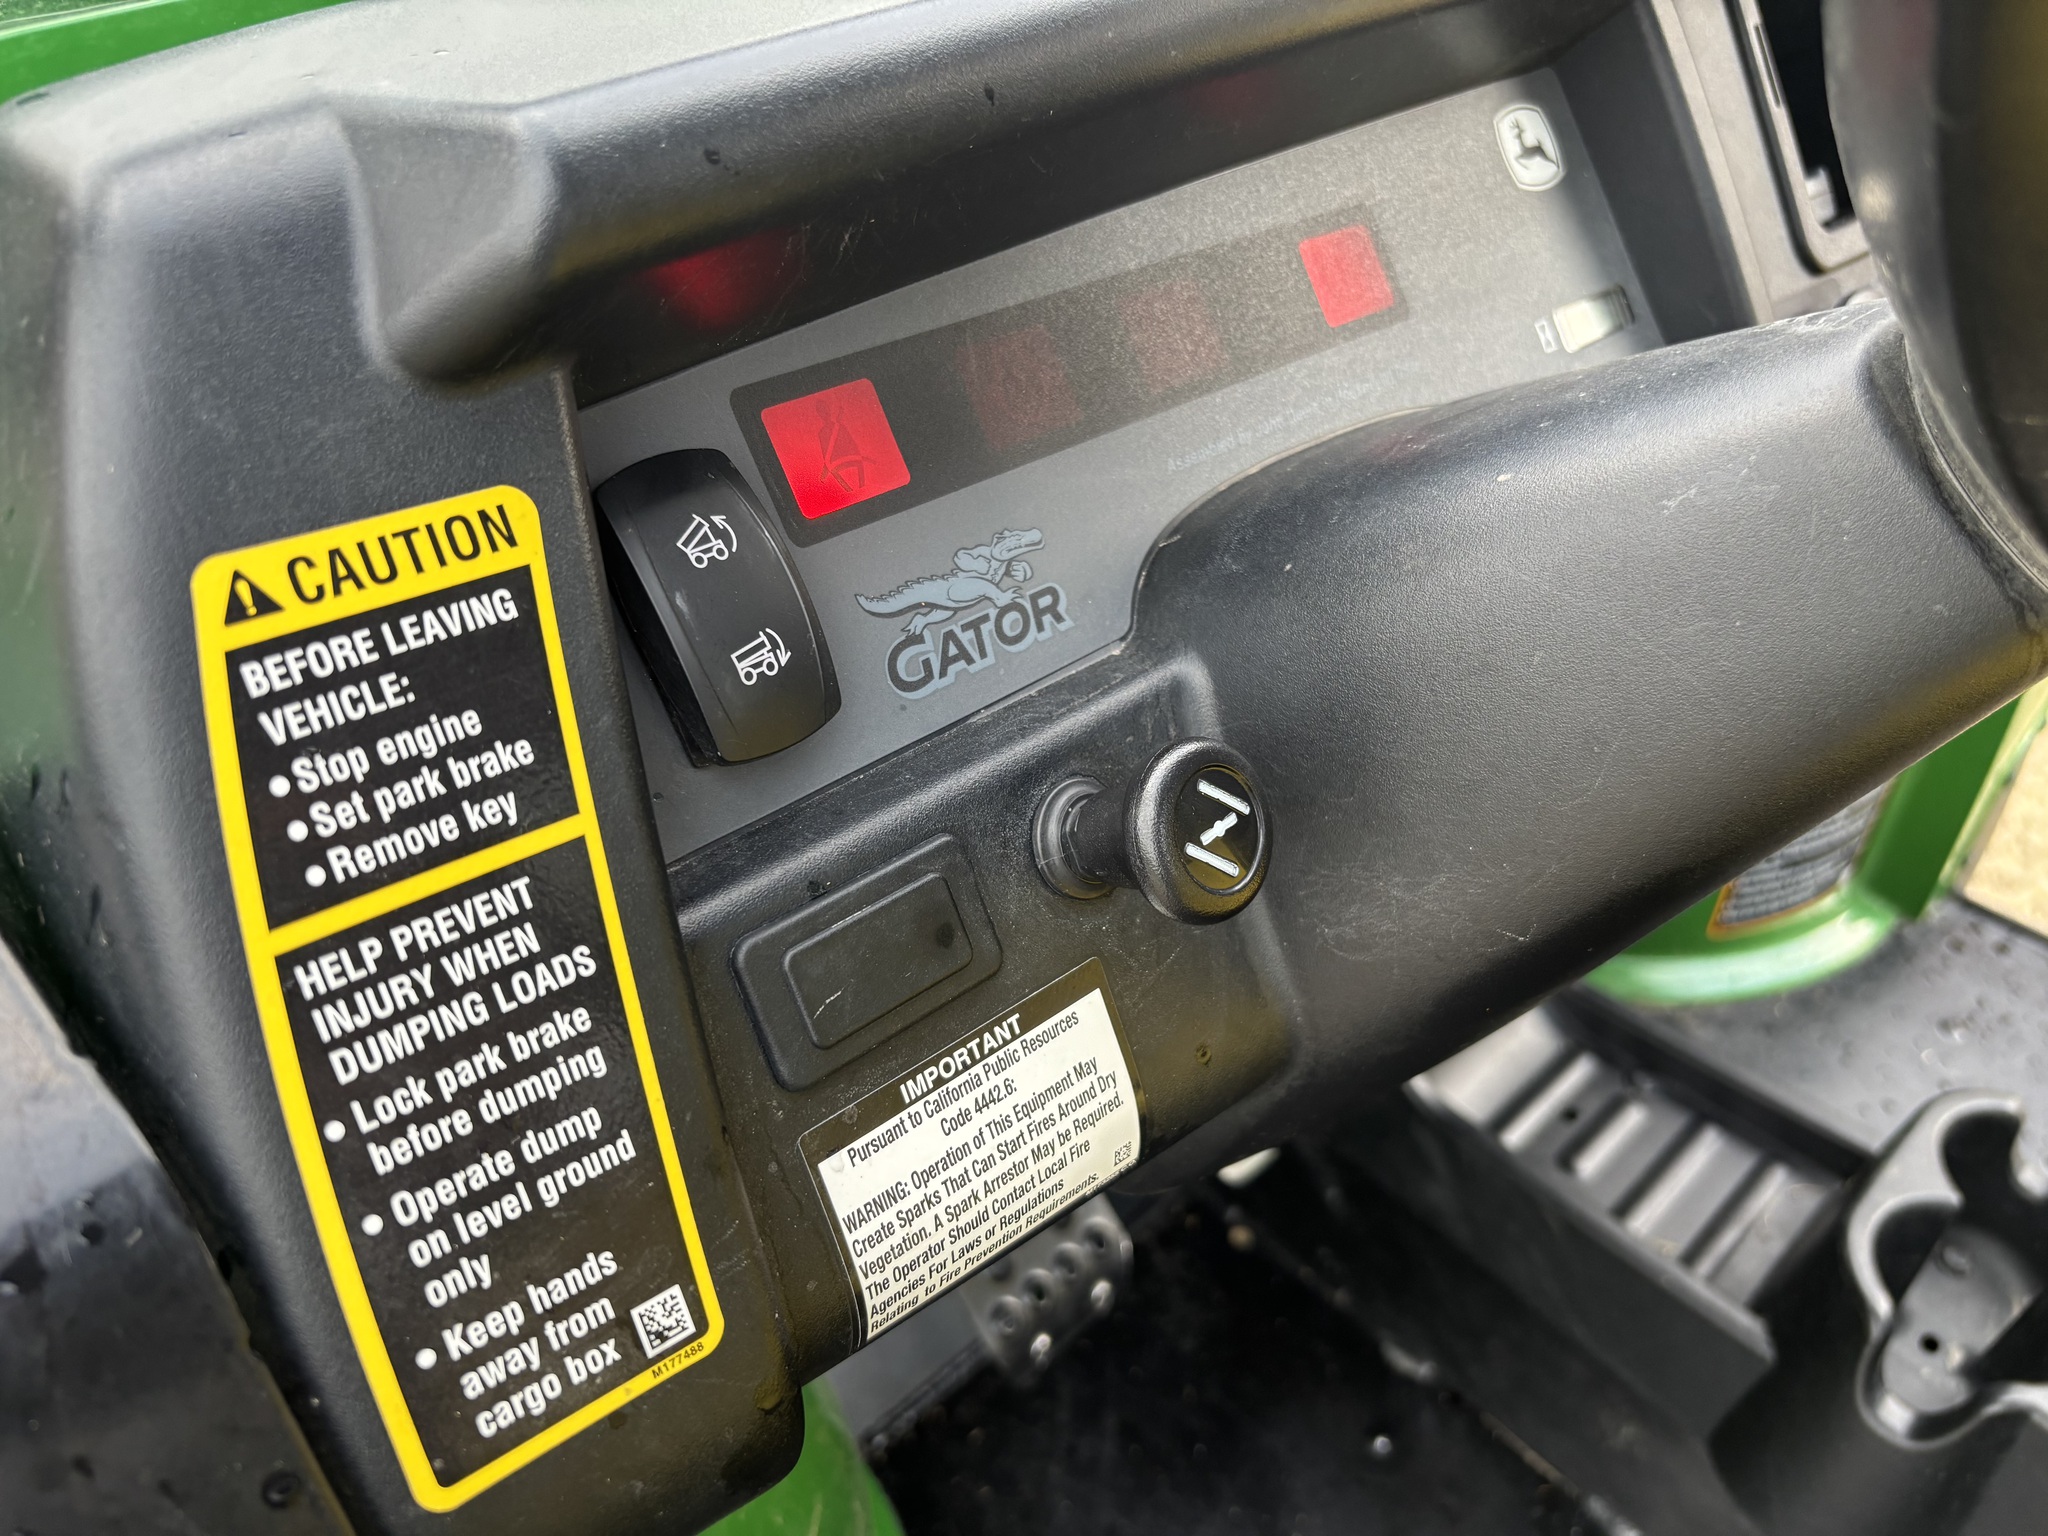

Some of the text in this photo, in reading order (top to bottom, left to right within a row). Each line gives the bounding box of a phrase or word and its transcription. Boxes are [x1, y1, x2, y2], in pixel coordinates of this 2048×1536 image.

[286, 504, 519, 604] CAUTION
[239, 588, 520, 699] BEFORE LEAVING
[886, 584, 1070, 695] GATOR
[257, 671, 417, 747] VEHICLE:
[291, 709, 483, 794] Stop engine
[308, 738, 535, 839] Set park brake
[326, 790, 520, 885] Remove key
[293, 875, 535, 1001] HELP PREVENT
[310, 921, 542, 1044] INJURY WHEN
[328, 944, 598, 1086] DUMPING LOADS
[349, 1006, 593, 1135] Lock park brake
[900, 1013, 1020, 1104] IMPORTANT
[367, 1044, 608, 1176] before dumping
[842, 1056, 1098, 1234] WARNING: Operation of This Equipment May
[847, 1011, 1080, 1168] Pursuant to California Public Resources
[940, 1078, 1017, 1136] Code 4442.6:
[389, 1104, 604, 1227] Operate dump
[407, 1128, 637, 1269] on level ground
[852, 1070, 1118, 1258] Create Sparks That Can Start Fires Around Dry
[858, 1091, 1124, 1280] Vegetation. A Spark Arrestor May be Required.
[865, 1277, 890, 1300] The
[892, 1237, 946, 1282] Operator
[948, 1206, 990, 1245] Should
[992, 1174, 1036, 1216] Contact
[1037, 1152, 1068, 1184] Local
[1069, 1140, 1090, 1162] Fire
[423, 1252, 492, 1309] only
[441, 1248, 618, 1362] Keep hands
[870, 1274, 926, 1320] Agencies
[928, 1256, 948, 1280] For
[951, 1234, 982, 1264] Laws
[984, 1224, 997, 1241] or
[1000, 1178, 1064, 1231] Regulations
[870, 1294, 920, 1333] Relating
[924, 1283, 936, 1297] to
[939, 1266, 962, 1288] Fire
[964, 1224, 1022, 1271] Prevention
[1026, 1172, 1100, 1229] Requirements.
[459, 1297, 616, 1400] away from
[474, 1337, 622, 1439] cargo box
[651, 1342, 704, 1379] M177488
